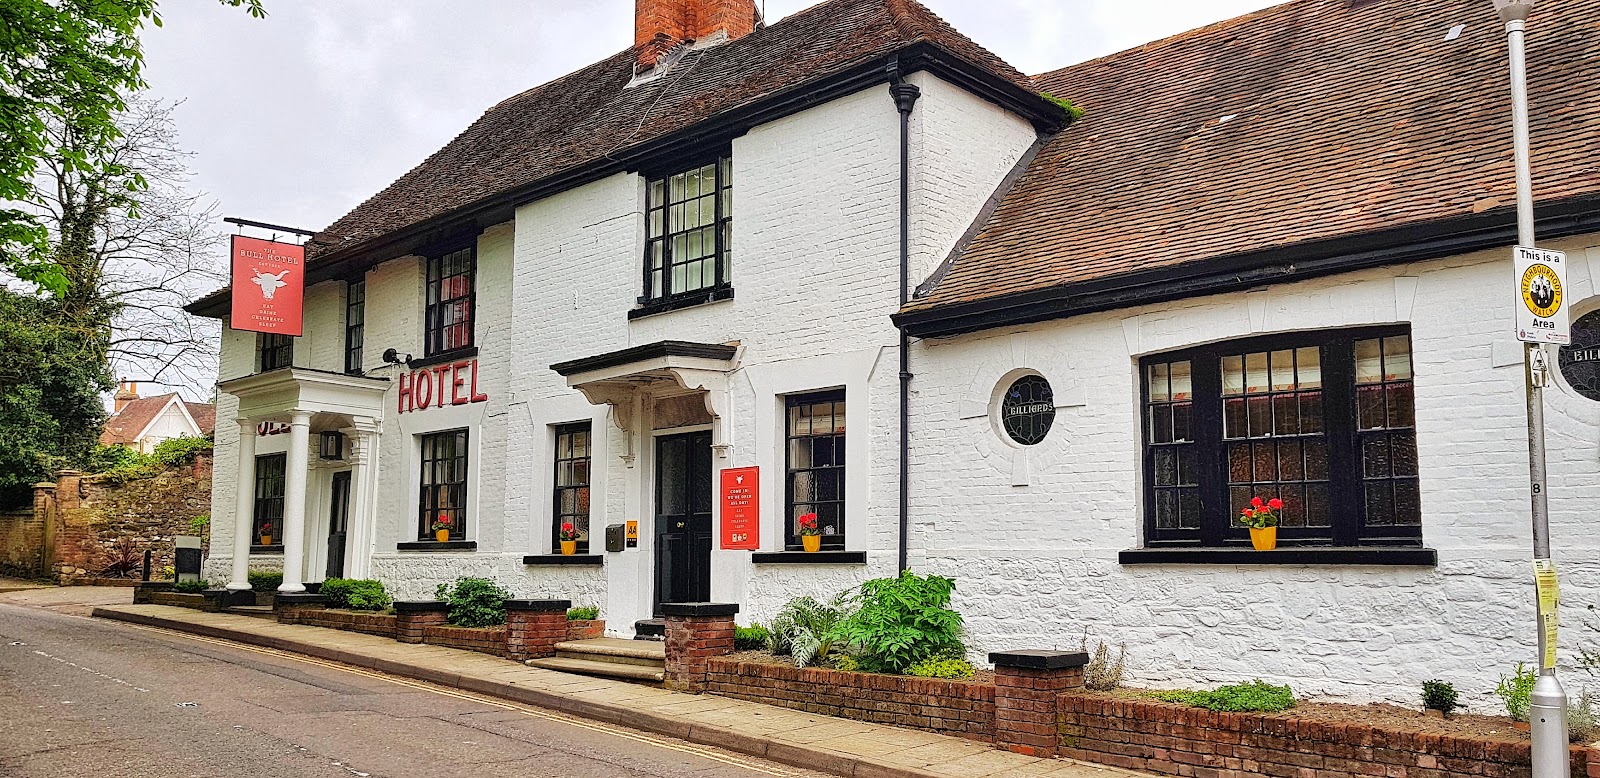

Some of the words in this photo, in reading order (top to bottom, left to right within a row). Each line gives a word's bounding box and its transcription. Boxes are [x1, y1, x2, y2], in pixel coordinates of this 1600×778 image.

[240, 249, 264, 260] BULL
[267, 254, 299, 265] HOTEL
[1519, 249, 1540, 261] This
[1543, 252, 1551, 262] is
[1554, 255, 1560, 263] a
[1522, 265, 1561, 296] NEIGHBOURHOOD
[1532, 305, 1554, 316] WATCH
[251, 314, 284, 323] CELEBRATE
[1532, 318, 1555, 328] Area
[398, 358, 488, 414] HOTEL
[1010, 403, 1053, 415] BILLIARDS
[1533, 483, 1541, 494] 8
[627, 525, 637, 535] AA
